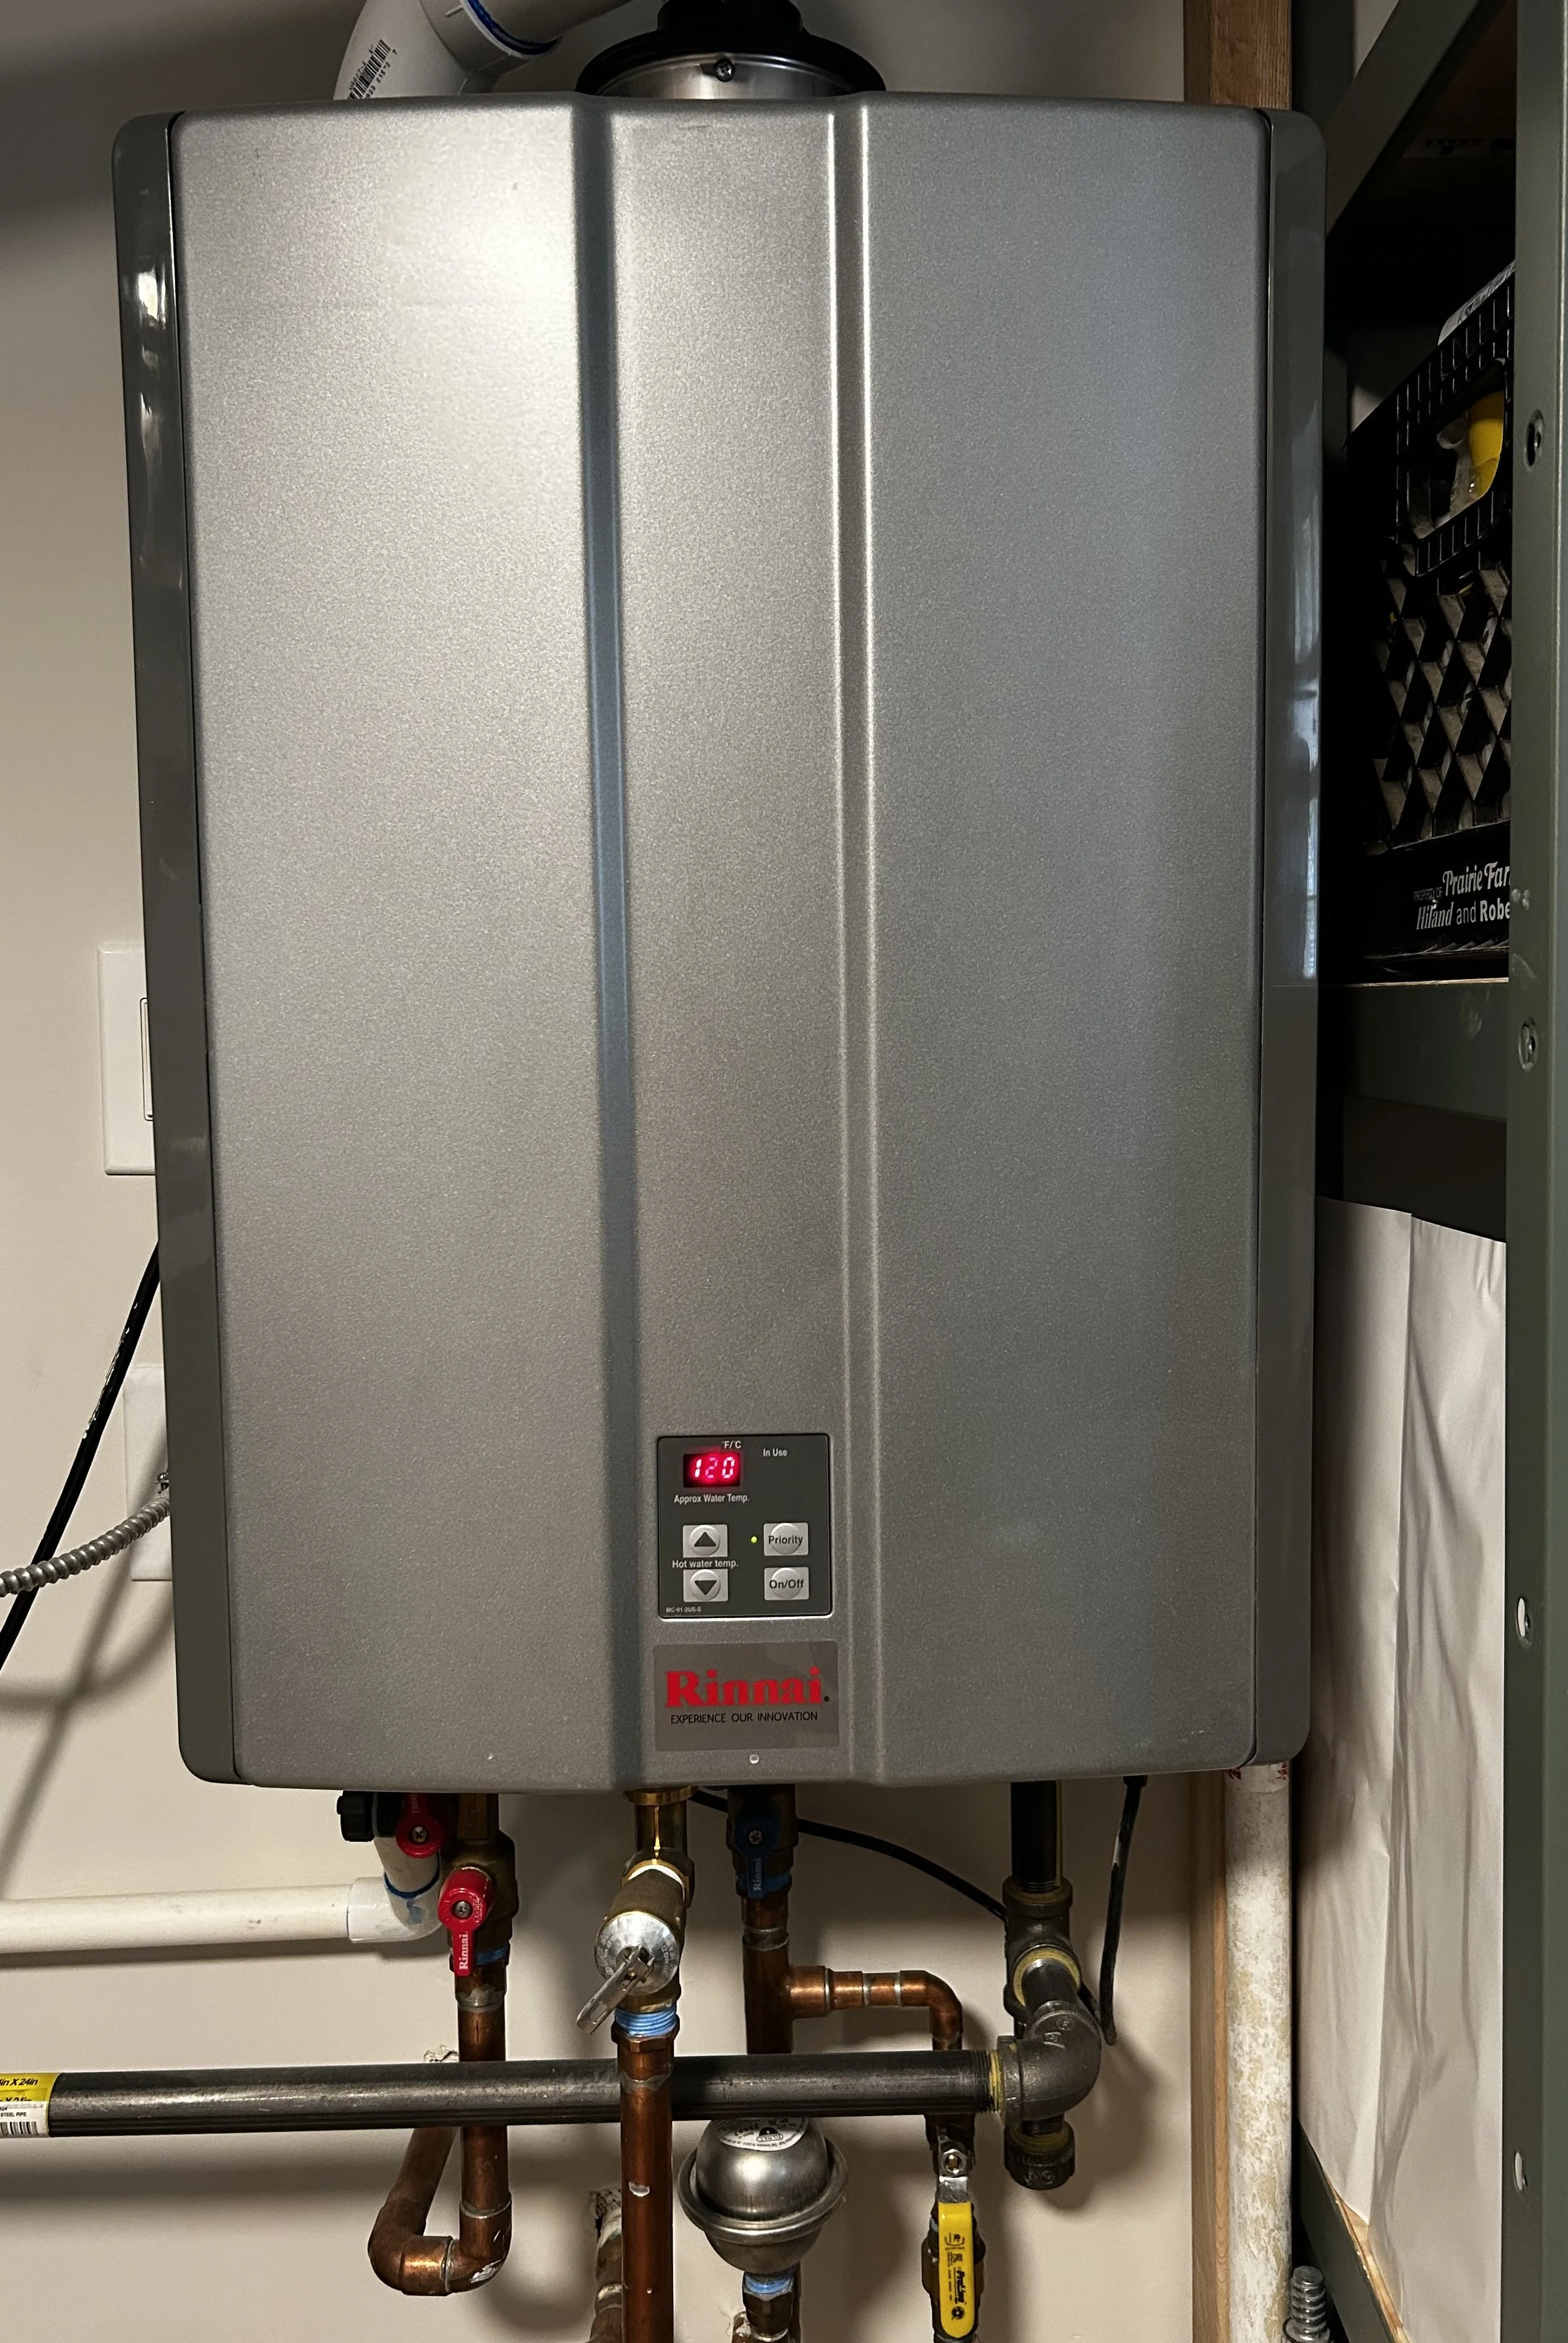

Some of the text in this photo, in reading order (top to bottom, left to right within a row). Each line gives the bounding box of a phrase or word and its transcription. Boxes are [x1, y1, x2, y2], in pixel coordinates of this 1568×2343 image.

[1414, 861, 1510, 901] PROPERTY OF Prairie Far
[1416, 902, 1454, 930] Hiland
[1456, 901, 1476, 925] and
[773, 1448, 788, 1457] Use
[694, 1456, 735, 1479] 120
[674, 1494, 750, 1505] Approx Water Temp.
[768, 1535, 803, 1547] Priority
[672, 1560, 687, 1568] Hot
[715, 1560, 739, 1568] temp.
[769, 1579, 804, 1589] On/Off
[665, 1666, 824, 1708] Rinnai
[670, 1711, 818, 1723] EXPERIENCE OUR INNOVATION
[753, 1857, 761, 1891] Rinnai
[458, 1934, 469, 1970] Rinnai
[19, 2078, 39, 2086] 24in
